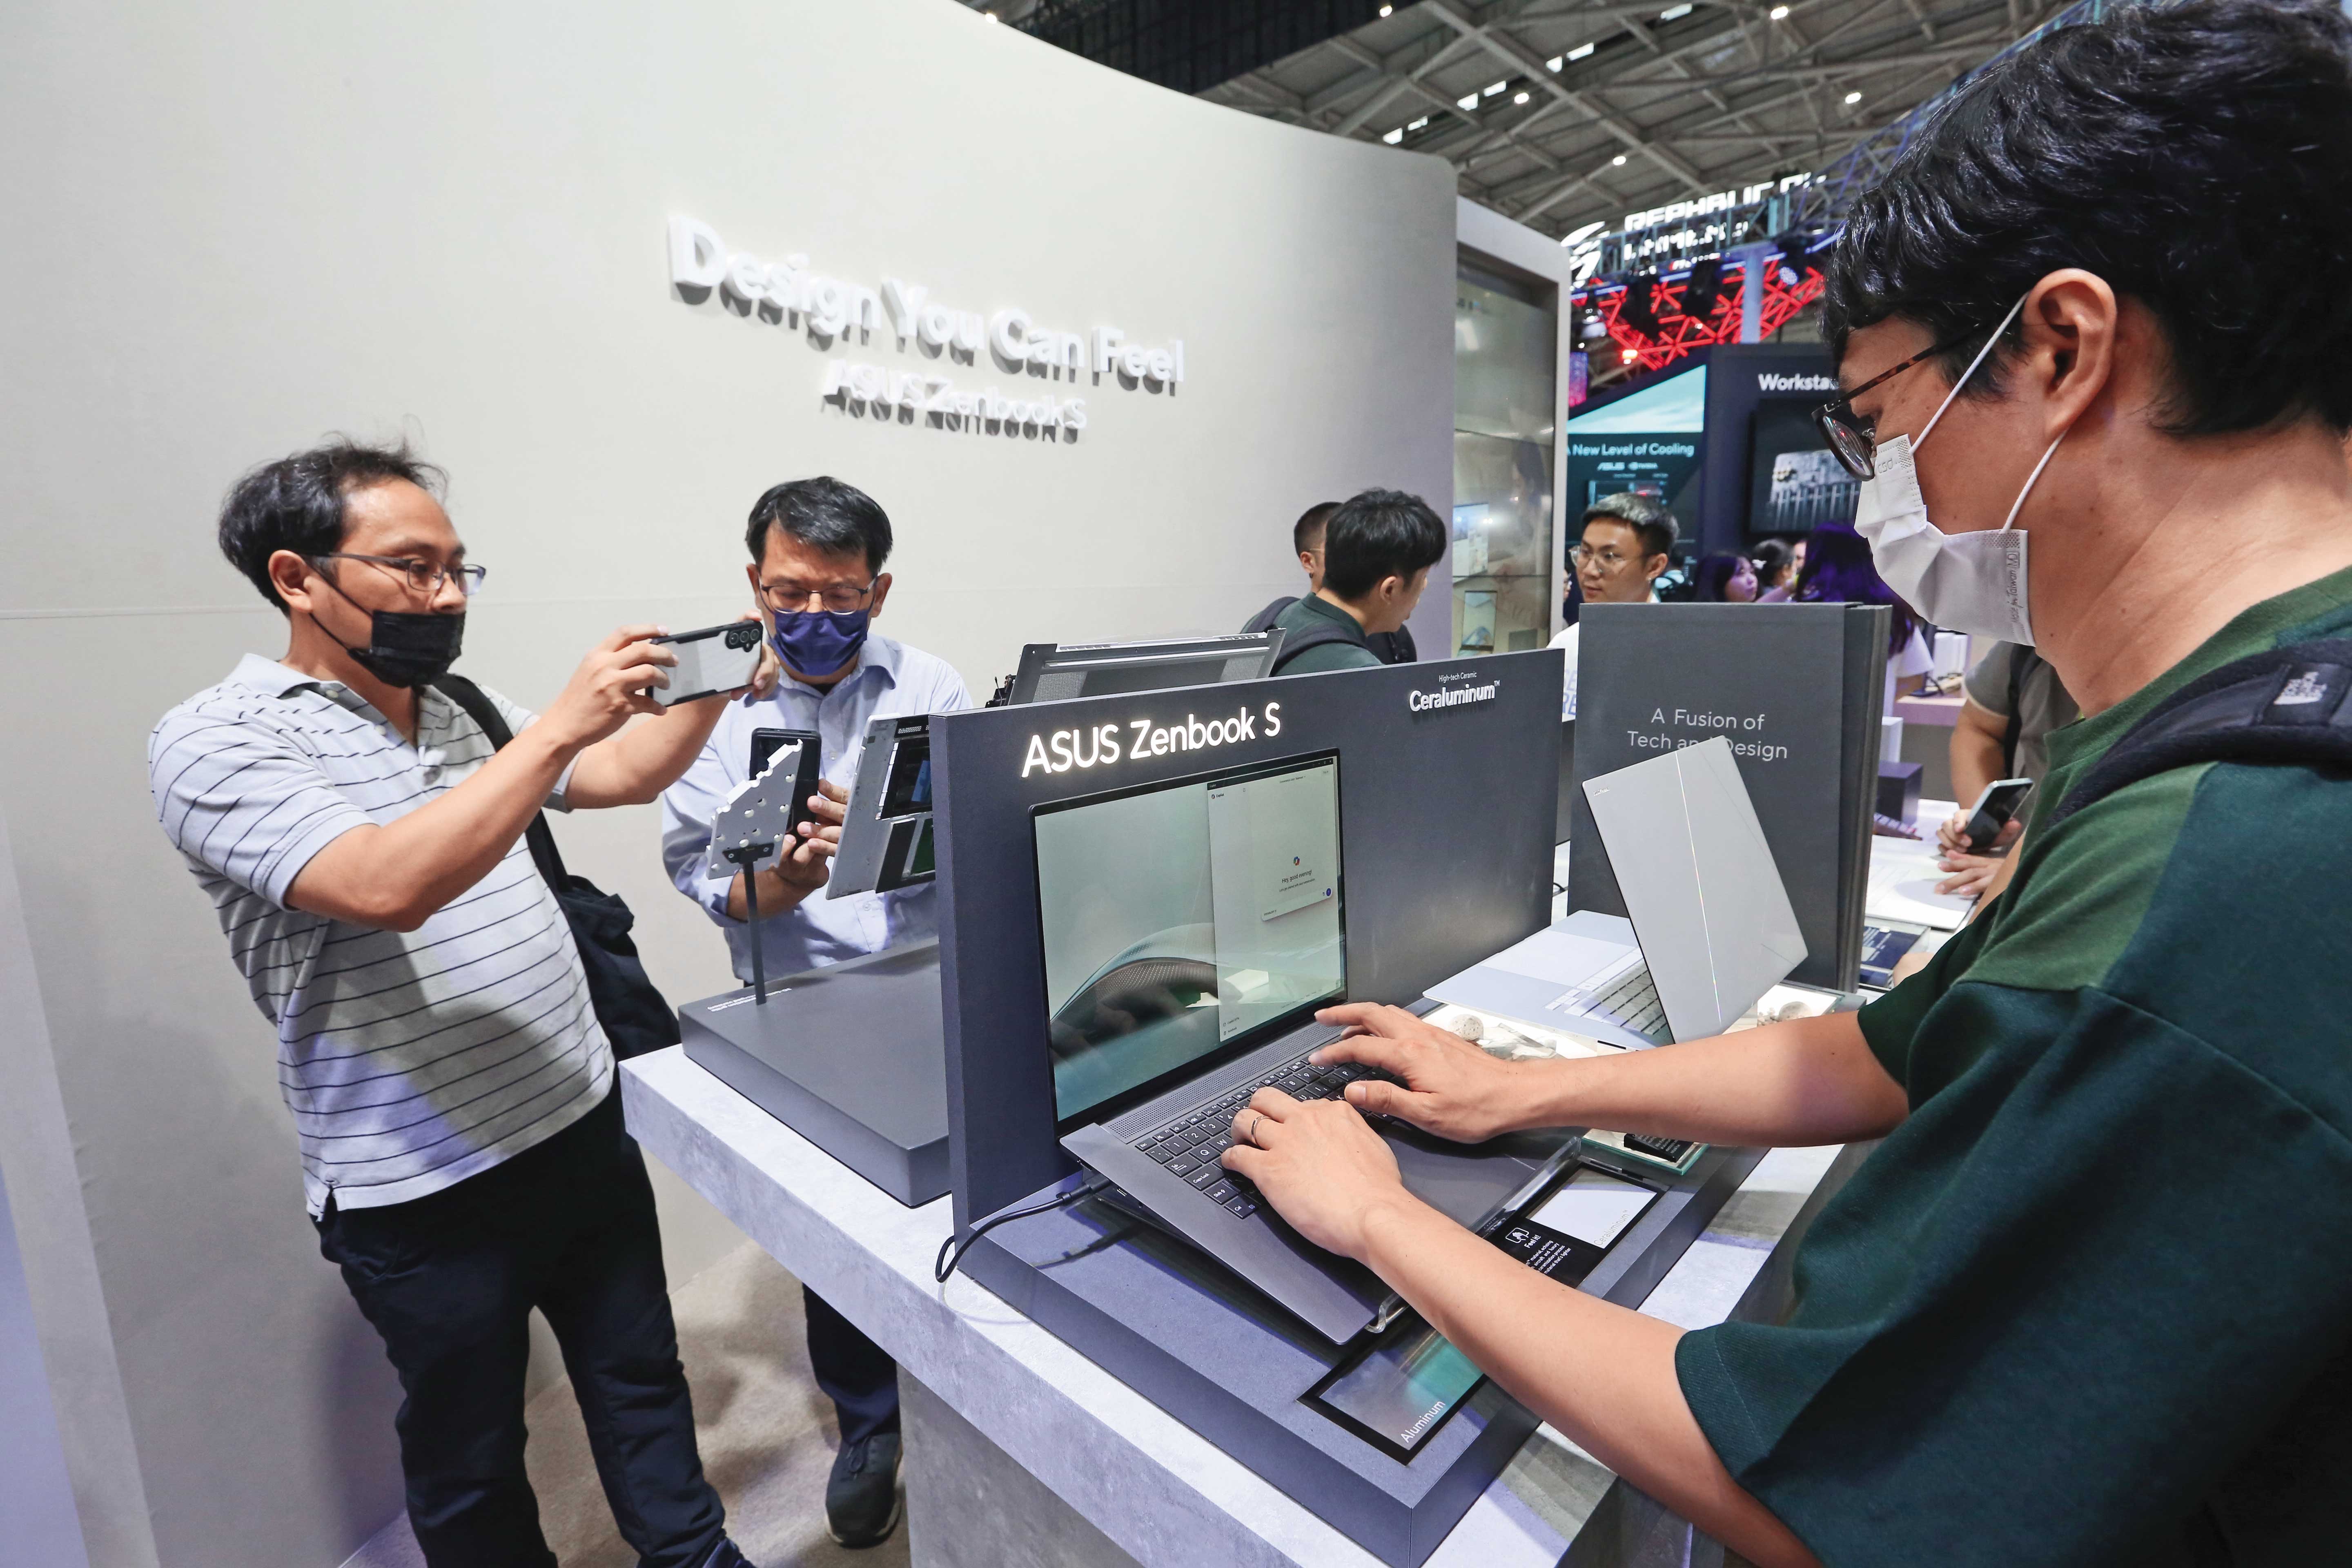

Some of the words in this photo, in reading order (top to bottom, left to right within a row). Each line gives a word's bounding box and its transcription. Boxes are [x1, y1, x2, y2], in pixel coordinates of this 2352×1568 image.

[667, 215, 882, 336] Design
[881, 276, 985, 346] You
[990, 307, 1085, 368] Can
[1089, 325, 1184, 383] Feel
[1757, 373, 1831, 391] Worksta
[822, 359, 926, 408] ASUS
[924, 376, 1065, 427] Zenbook
[1062, 397, 1087, 429] S
[1572, 443, 1600, 456] New
[1601, 443, 1633, 456] Level
[1634, 443, 1647, 456] of
[1649, 443, 1694, 457] Cooling
[2007, 570, 2018, 596] Taiwan
[1439, 673, 1460, 683] High-tech
[1460, 671, 1477, 679] Ceramic
[1651, 708, 1665, 724] A
[1675, 709, 1737, 728] Fusion
[1744, 714, 1765, 730] of
[1021, 724, 1120, 778] ASUS
[1129, 706, 1256, 760] Zenbook
[1264, 702, 1281, 737] S
[1627, 731, 1671, 749] Tech
[1298, 869, 1312, 878] evening!
[1524, 1237, 1537, 1248] Feel
[1554, 1245, 1566, 1256] process
[1400, 1401, 1446, 1443] Aluminum
